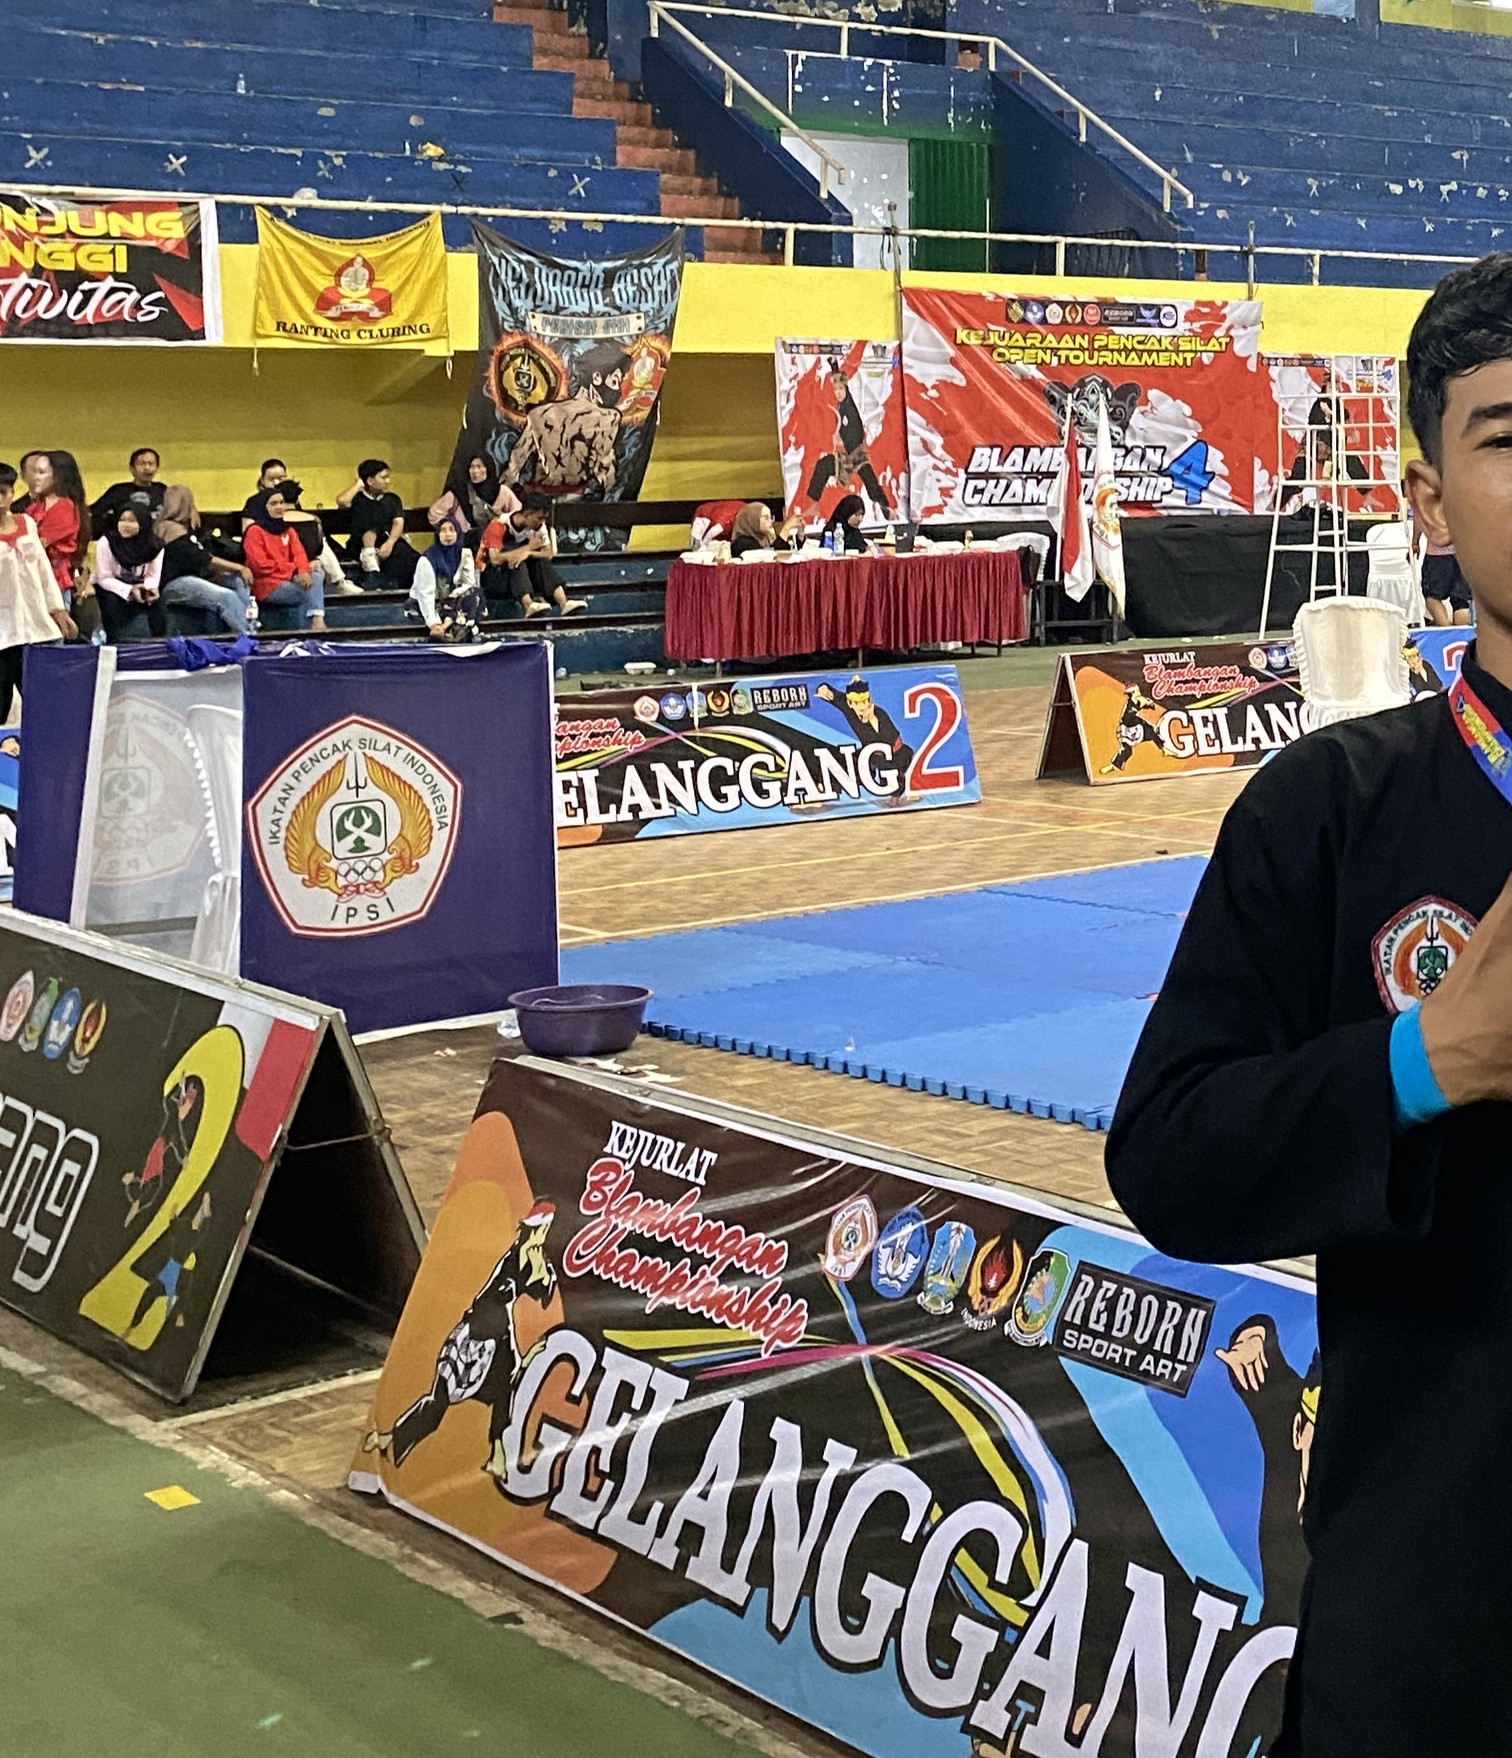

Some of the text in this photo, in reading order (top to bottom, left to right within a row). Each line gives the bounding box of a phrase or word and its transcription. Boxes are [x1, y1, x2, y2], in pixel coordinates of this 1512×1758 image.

[0, 203, 185, 238] NJUNG
[0, 271, 169, 325] tivitas
[275, 320, 351, 340] RANTING
[955, 328, 1231, 352] KEJUARAAN PENCAK SILAT
[992, 347, 1199, 367] OPEN TOURNAMENT
[1166, 439, 1216, 505] 4
[1142, 651, 1196, 665] KEJURLAT
[1142, 662, 1241, 683] Blambangan
[753, 685, 807, 705] REBORN
[1151, 673, 1261, 700] Championship
[555, 717, 621, 740] angan
[555, 728, 646, 759] pionship
[902, 682, 965, 796] 2
[1158, 700, 1310, 759] GELAN
[268, 737, 449, 846] IKATAN PENCAK SILAT INDONESIA
[330, 897, 396, 924] IPSI
[603, 1120, 718, 1185] KEJURLAT
[78, 1024, 244, 1351] 2
[579, 1157, 788, 1278] Blambangan
[563, 1217, 808, 1358] Championship
[1063, 1273, 1208, 1363] REBORN
[1062, 1328, 1136, 1367] SPORT
[1138, 1357, 1188, 1383] ART
